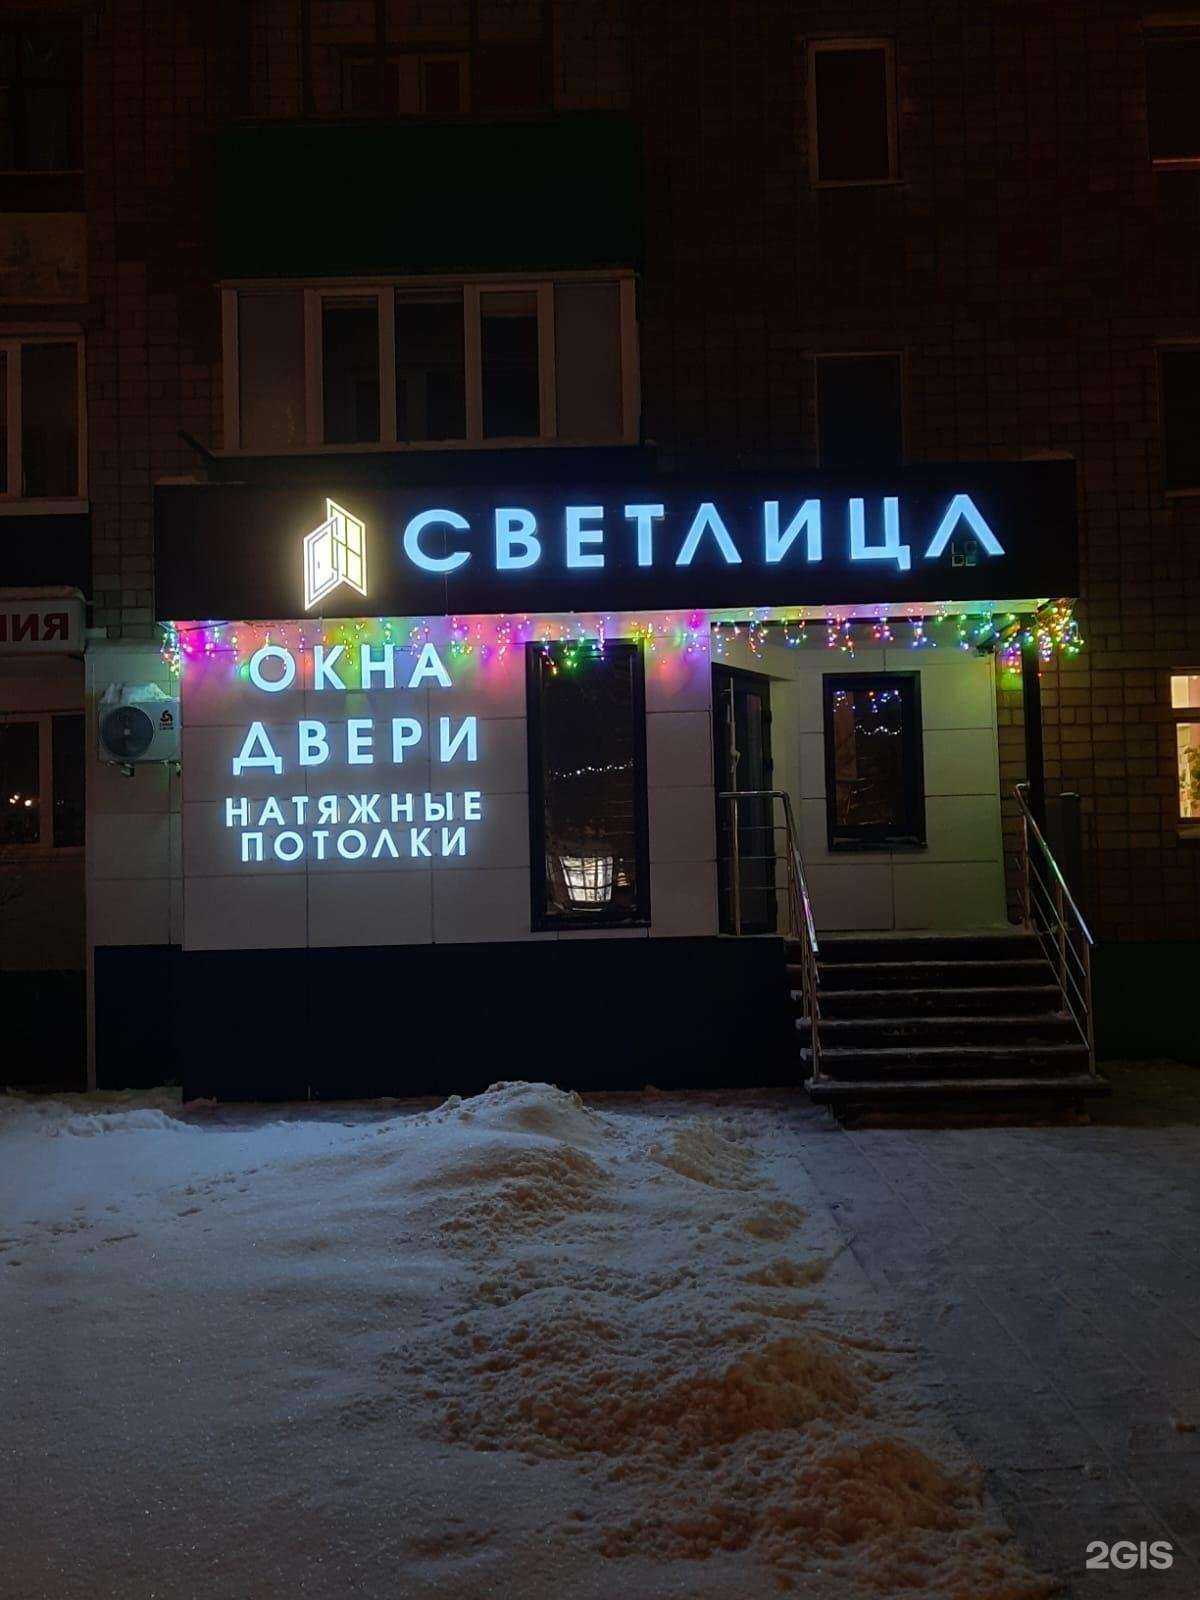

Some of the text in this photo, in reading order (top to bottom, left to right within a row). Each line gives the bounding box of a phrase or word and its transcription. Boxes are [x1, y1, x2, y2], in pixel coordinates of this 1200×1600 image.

[0, 613, 69, 641] ИЯ
[249, 643, 452, 692] ОКНА
[232, 716, 478, 775] ДВЕРИ
[225, 791, 482, 827] НАТЯЖНЫЕ
[241, 826, 467, 862] ПОТОЛКИ
